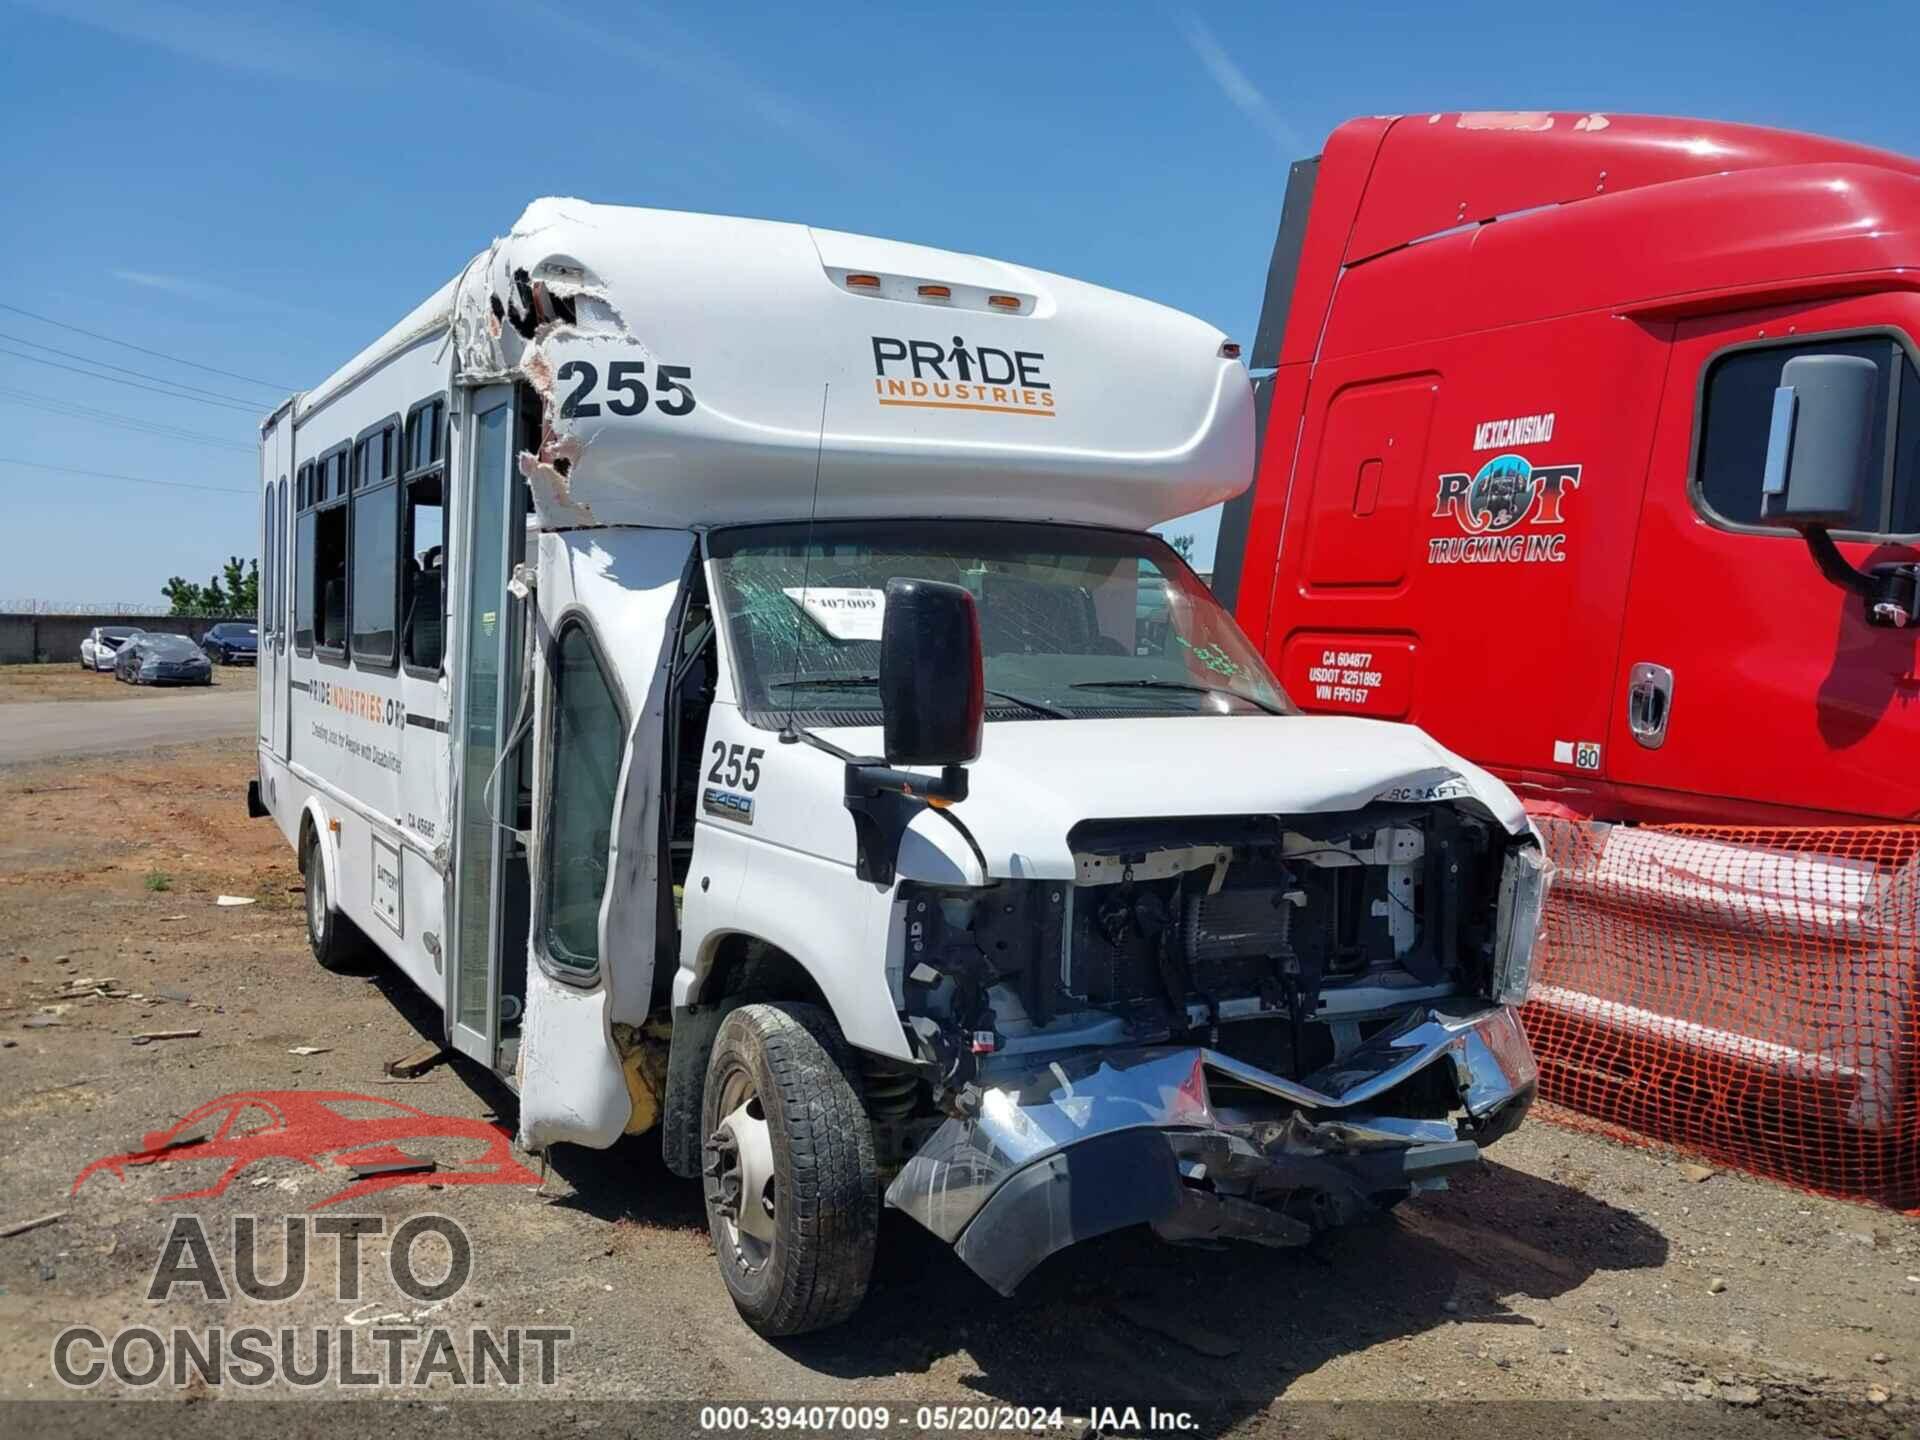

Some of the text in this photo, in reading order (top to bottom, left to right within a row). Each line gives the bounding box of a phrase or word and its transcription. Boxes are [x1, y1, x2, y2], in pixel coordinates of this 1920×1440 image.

[871, 335, 1050, 389] PRIDE
[556, 360, 696, 419] 255
[875, 378, 1055, 407] INDUSTRIES
[1473, 413, 1555, 451] MEXICANISIMO
[1428, 533, 1567, 564] TRUCKING INC.
[1322, 651, 1372, 668] CA 604877
[1309, 667, 1382, 687] USDOT 3251892
[1316, 684, 1368, 704] VIN FP5157
[708, 740, 766, 792] 255
[1578, 749, 1598, 768] 80
